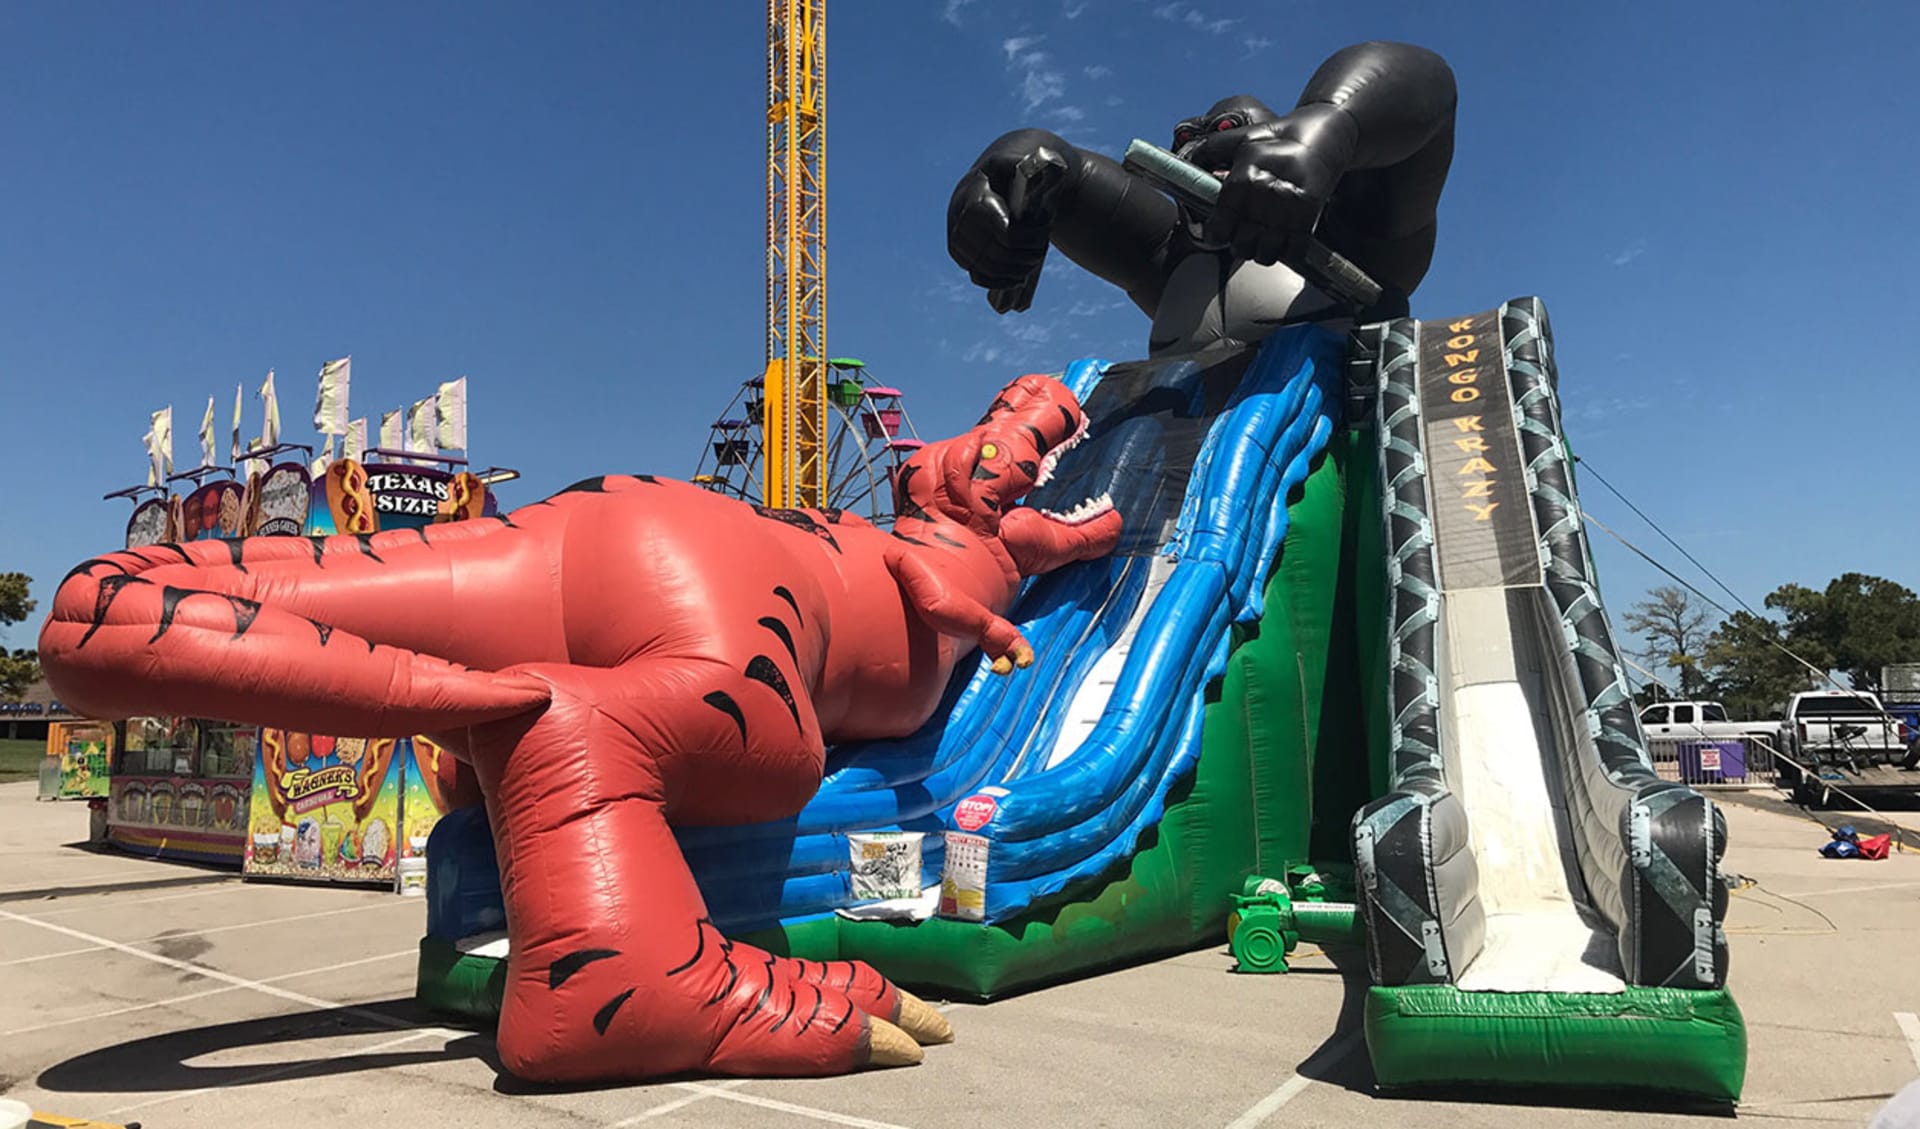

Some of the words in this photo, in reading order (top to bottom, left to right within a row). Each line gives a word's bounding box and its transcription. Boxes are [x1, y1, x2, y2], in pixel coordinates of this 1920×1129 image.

[1443, 318, 1480, 403] KONGO
[367, 472, 449, 501] TEXAS
[1453, 415, 1500, 521] KRAZY
[377, 494, 438, 516] SIZE
